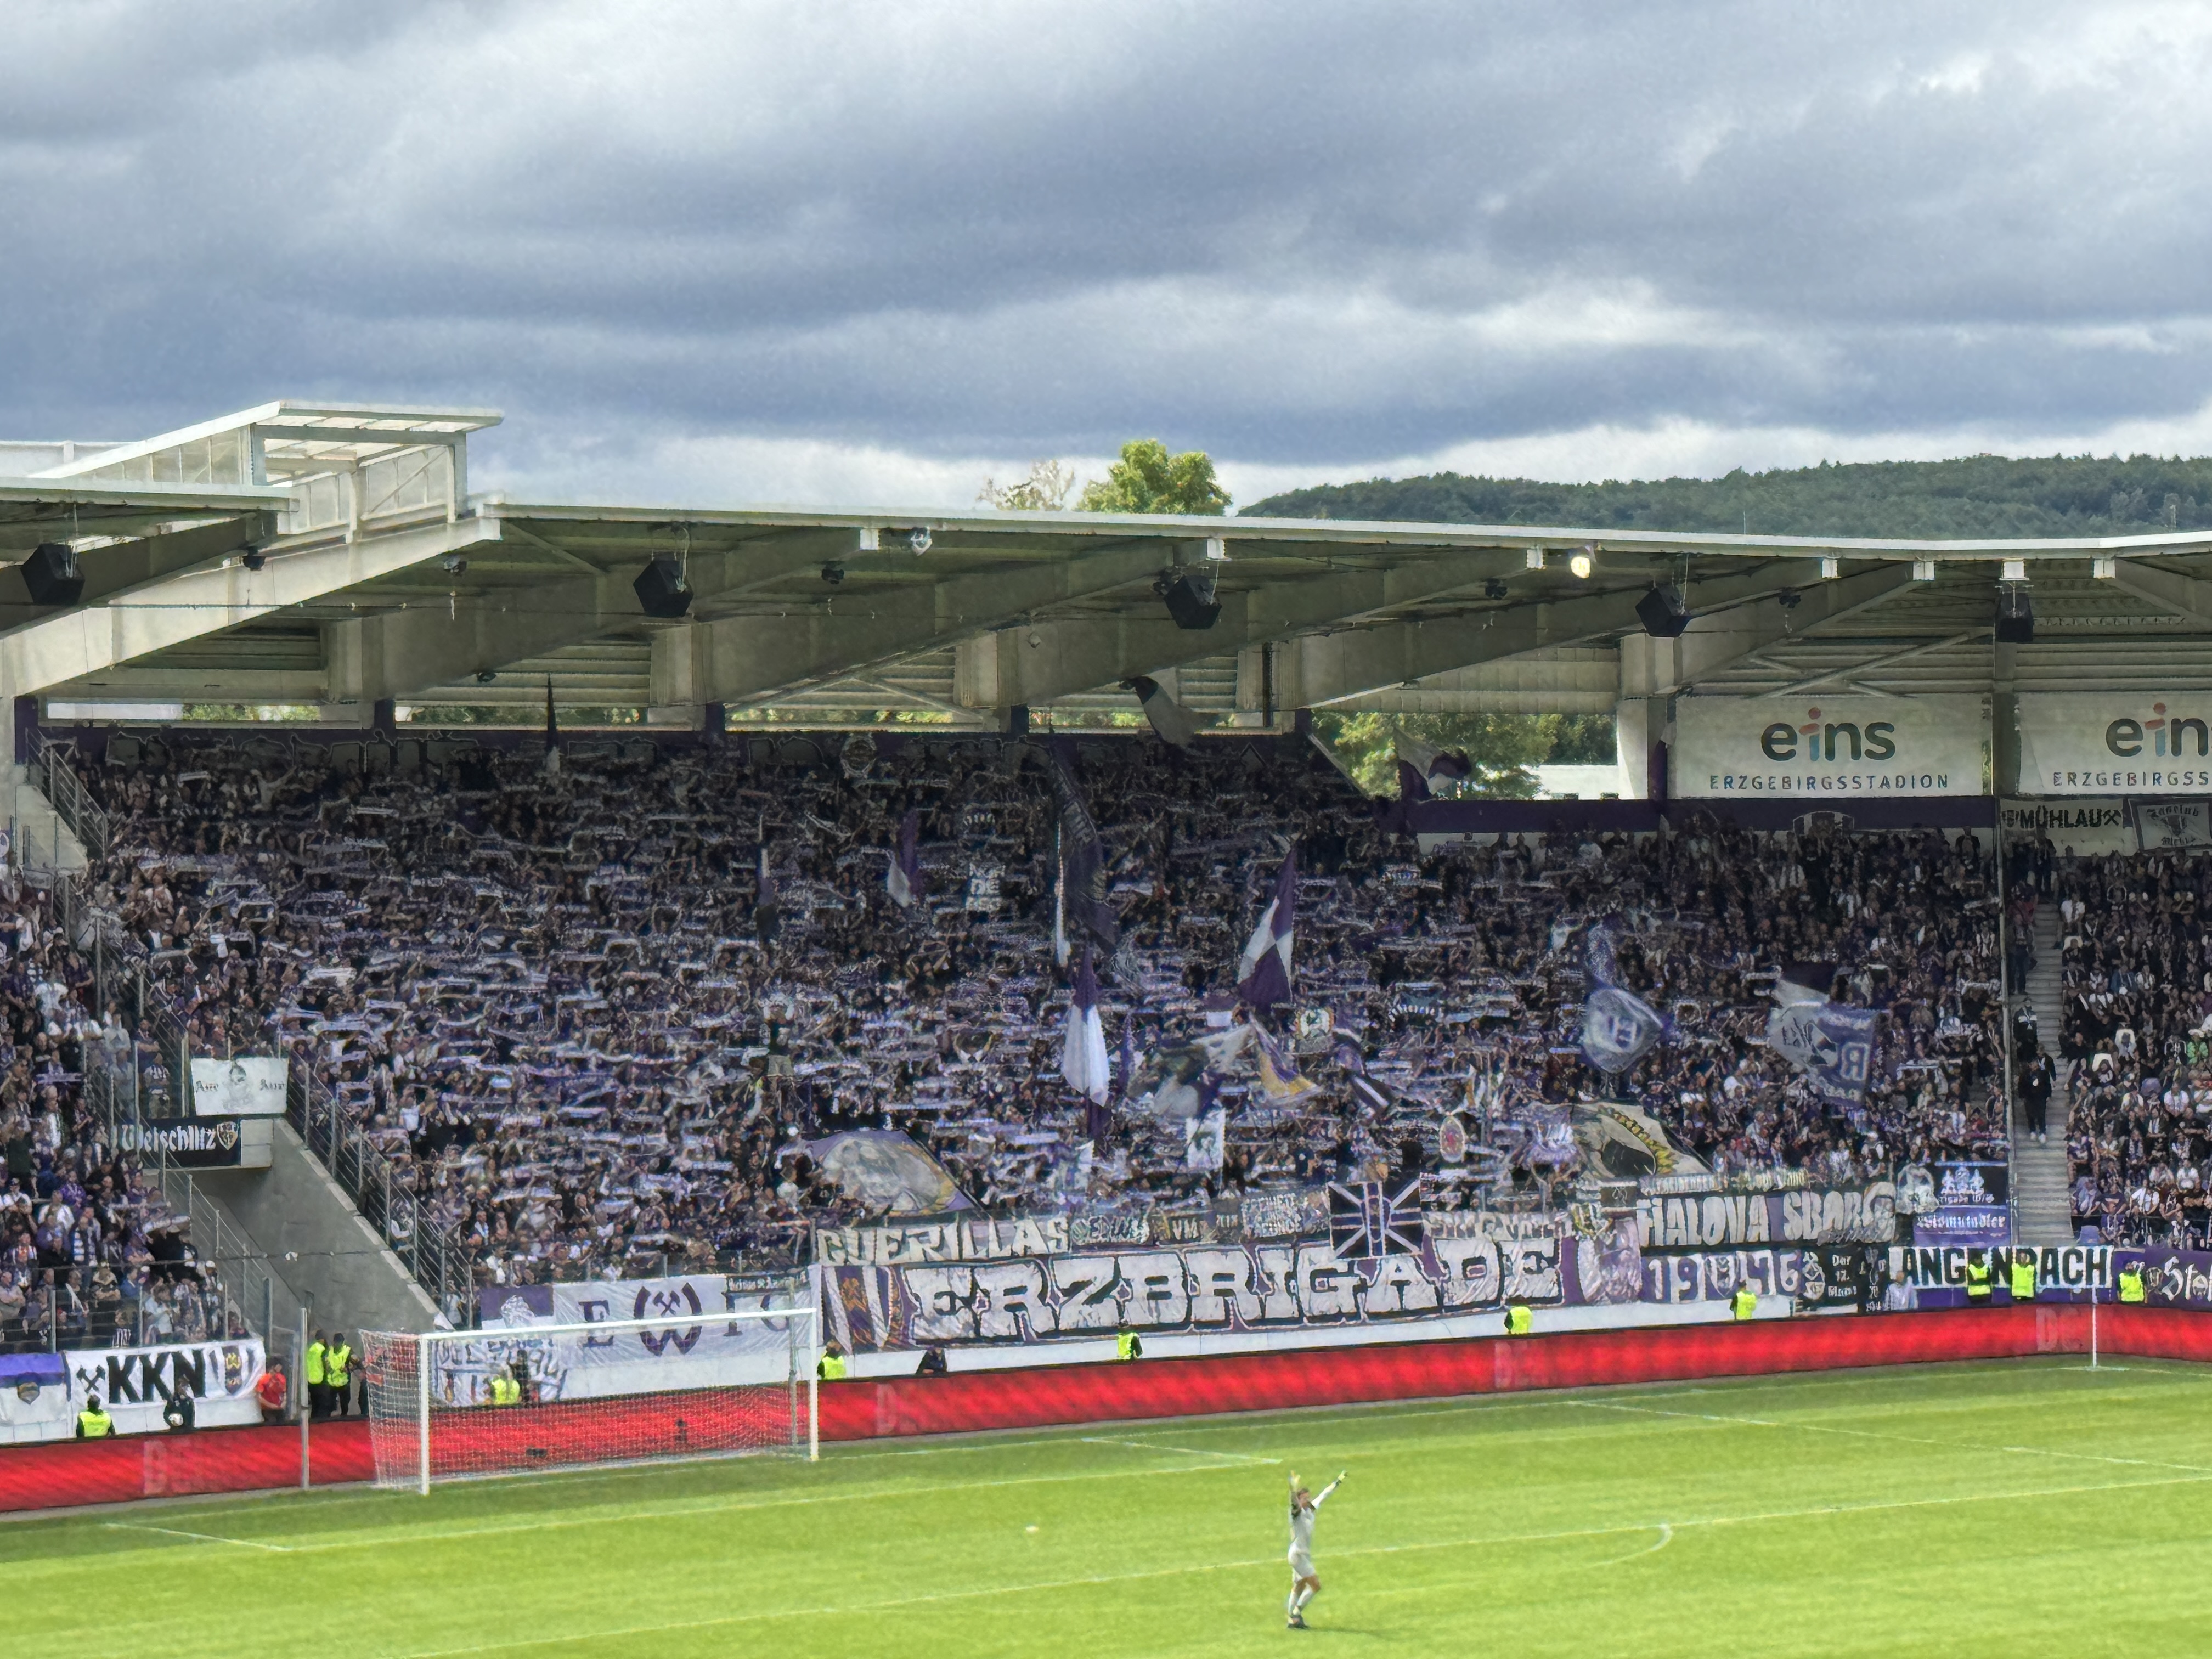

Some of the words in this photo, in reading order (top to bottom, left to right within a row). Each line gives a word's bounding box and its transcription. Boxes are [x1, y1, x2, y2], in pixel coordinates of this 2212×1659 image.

[1761, 707, 1896, 761] eins
[2106, 702, 2212, 757] ein
[1709, 775, 1948, 791] ERZGEBIRGSSTADION
[2019, 805, 2102, 828] MÜHLAU
[817, 1215, 1069, 1266] GUERILLAS
[901, 1237, 1565, 1347] ERZBRIGADE
[106, 1350, 208, 1404] KKN
